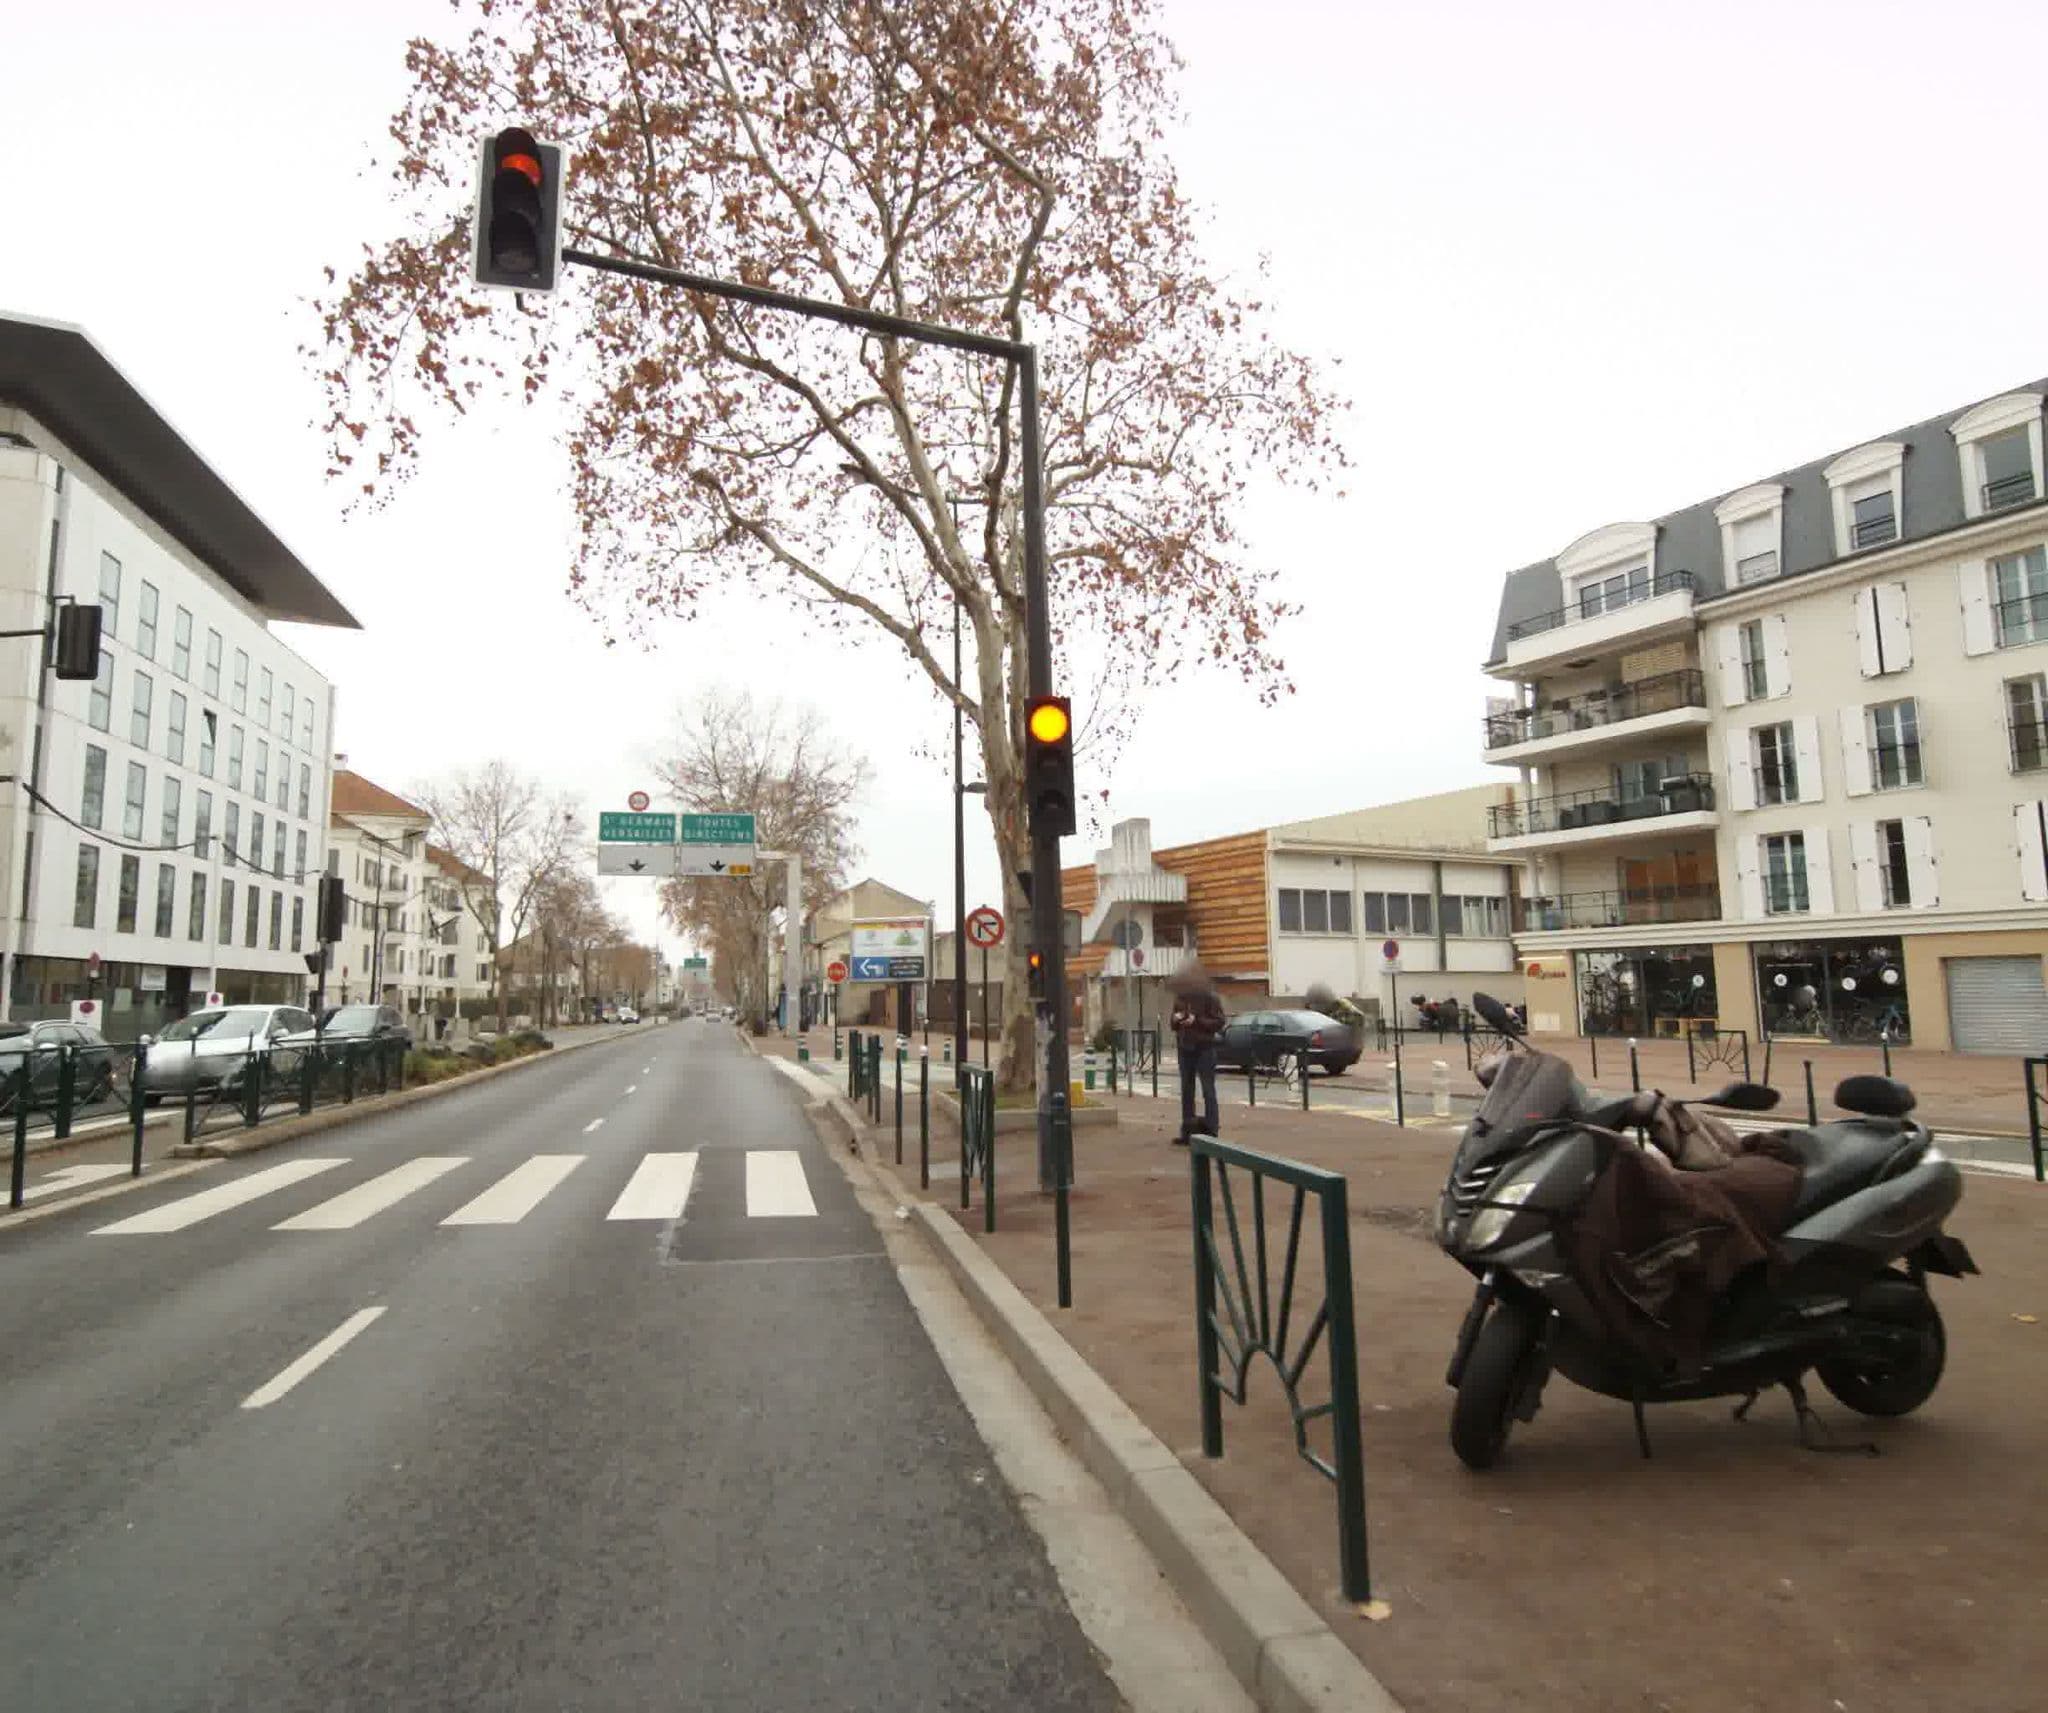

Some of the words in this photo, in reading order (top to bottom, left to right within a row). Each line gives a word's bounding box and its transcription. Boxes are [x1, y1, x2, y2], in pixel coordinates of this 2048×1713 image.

[619, 816, 673, 826] GERMAIN
[697, 818, 741, 828] TOUTES
[602, 829, 673, 839] VERSAILLES
[684, 830, 751, 840] DIRECTIONS
